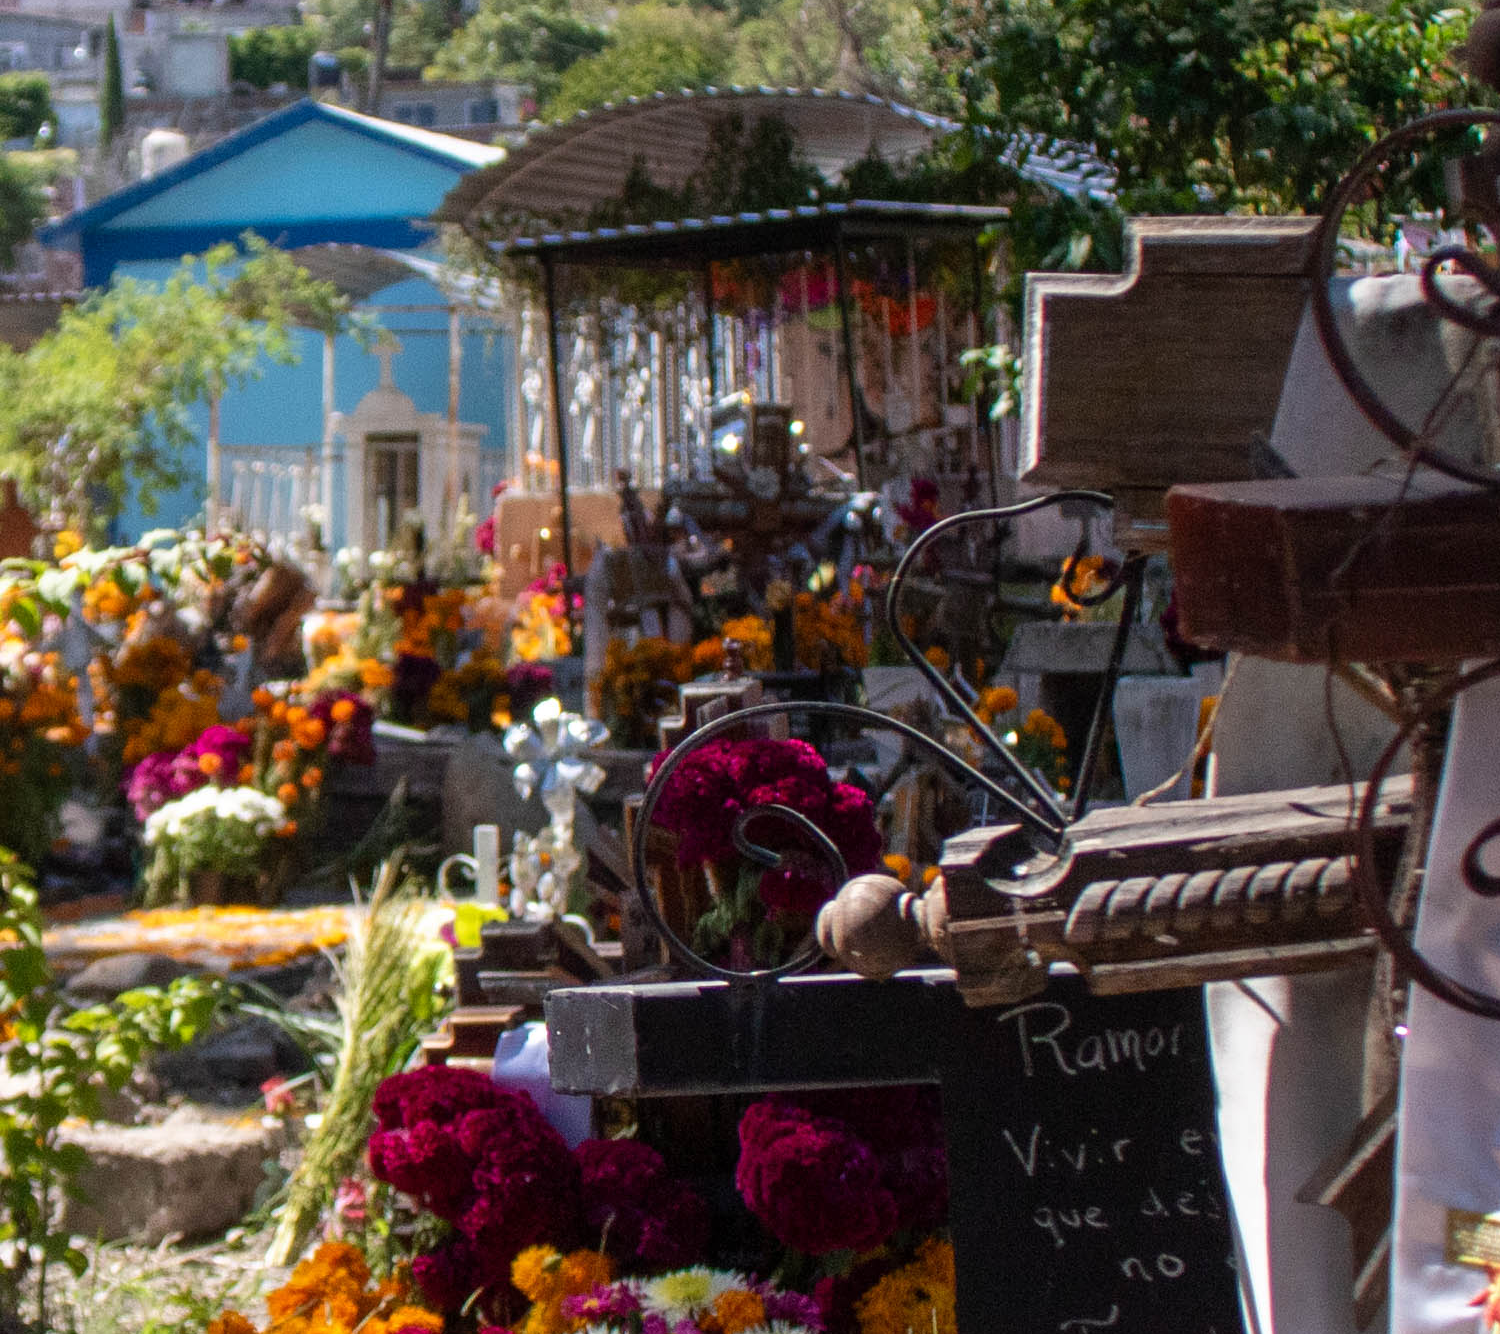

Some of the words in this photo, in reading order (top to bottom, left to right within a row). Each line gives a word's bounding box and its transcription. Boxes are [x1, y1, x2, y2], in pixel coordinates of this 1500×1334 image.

[1002, 1124, 1133, 1178] Vivir
[1033, 1206, 1109, 1249] que
[1120, 1251, 1186, 1282] no
